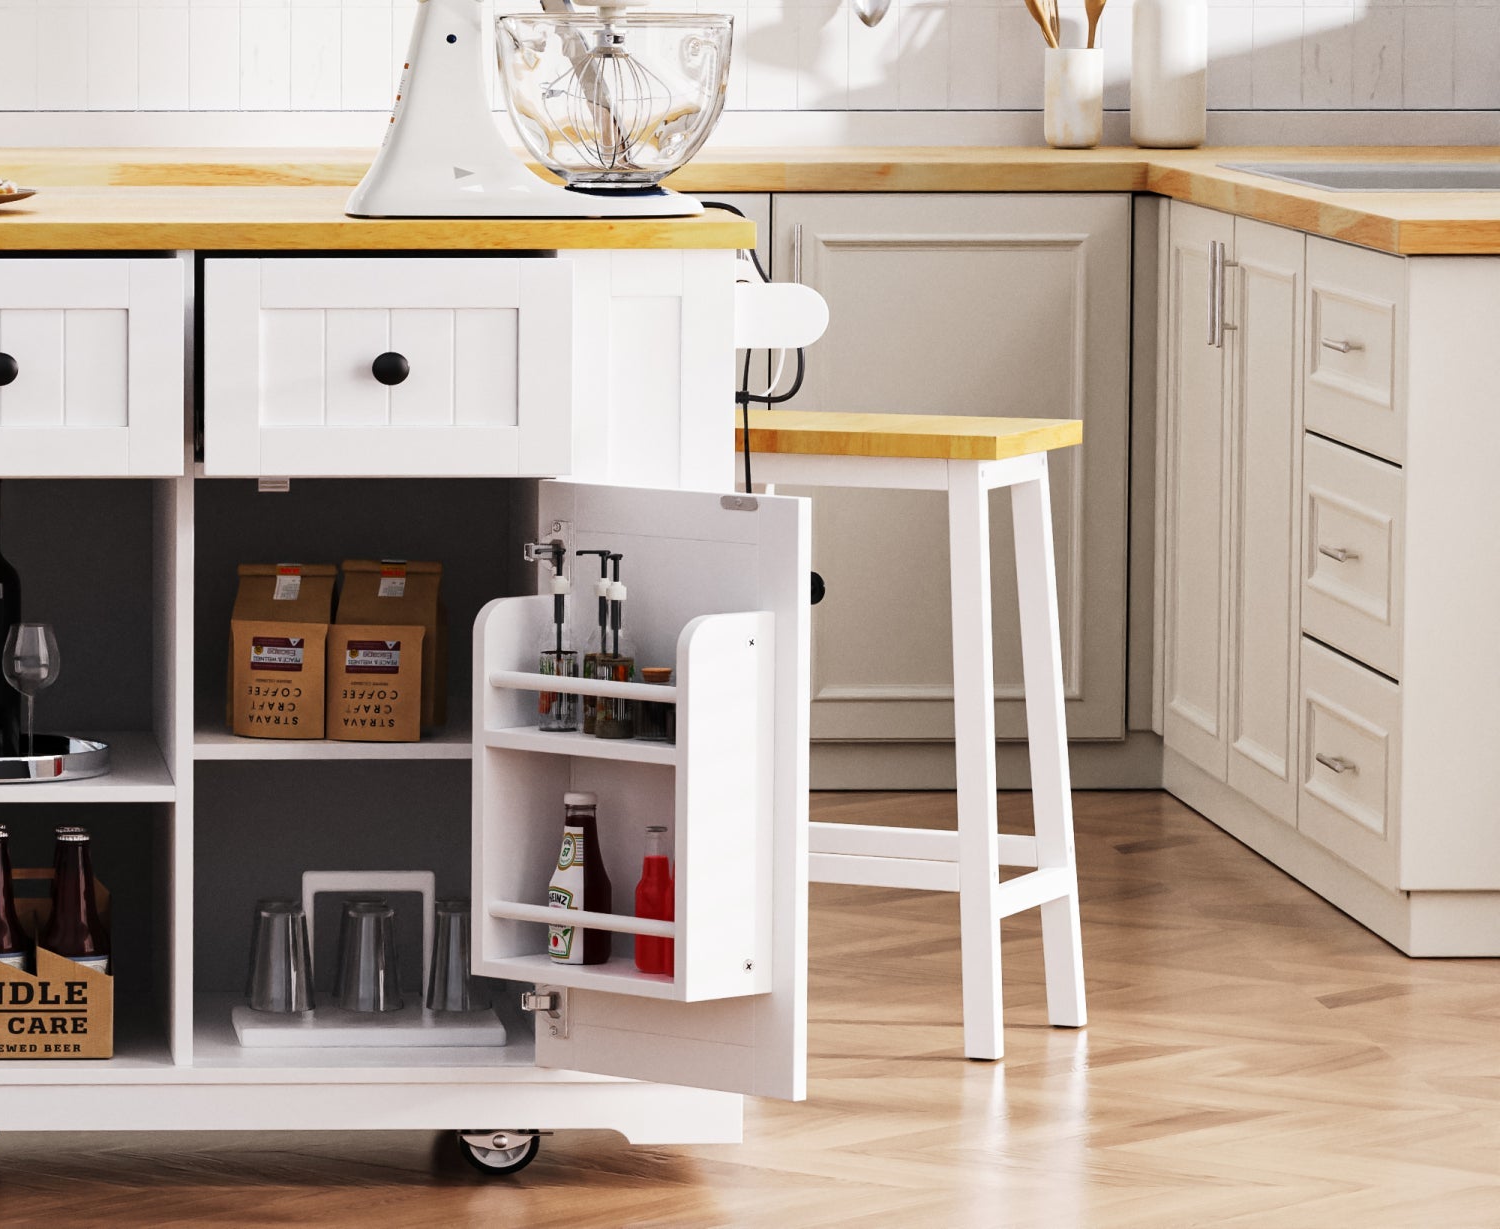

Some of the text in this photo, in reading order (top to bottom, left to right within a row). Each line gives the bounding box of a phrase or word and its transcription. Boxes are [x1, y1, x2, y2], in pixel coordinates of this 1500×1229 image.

[247, 686, 302, 697] COFFEE
[342, 689, 398, 700] COFFEE
[250, 701, 296, 711] CRAFT
[345, 704, 392, 714] CRAFT
[248, 715, 299, 725] STRAVA
[342, 718, 395, 728] STRAVA
[7, 1017, 88, 1035] CARE
[44, 1044, 81, 1053] BEER
